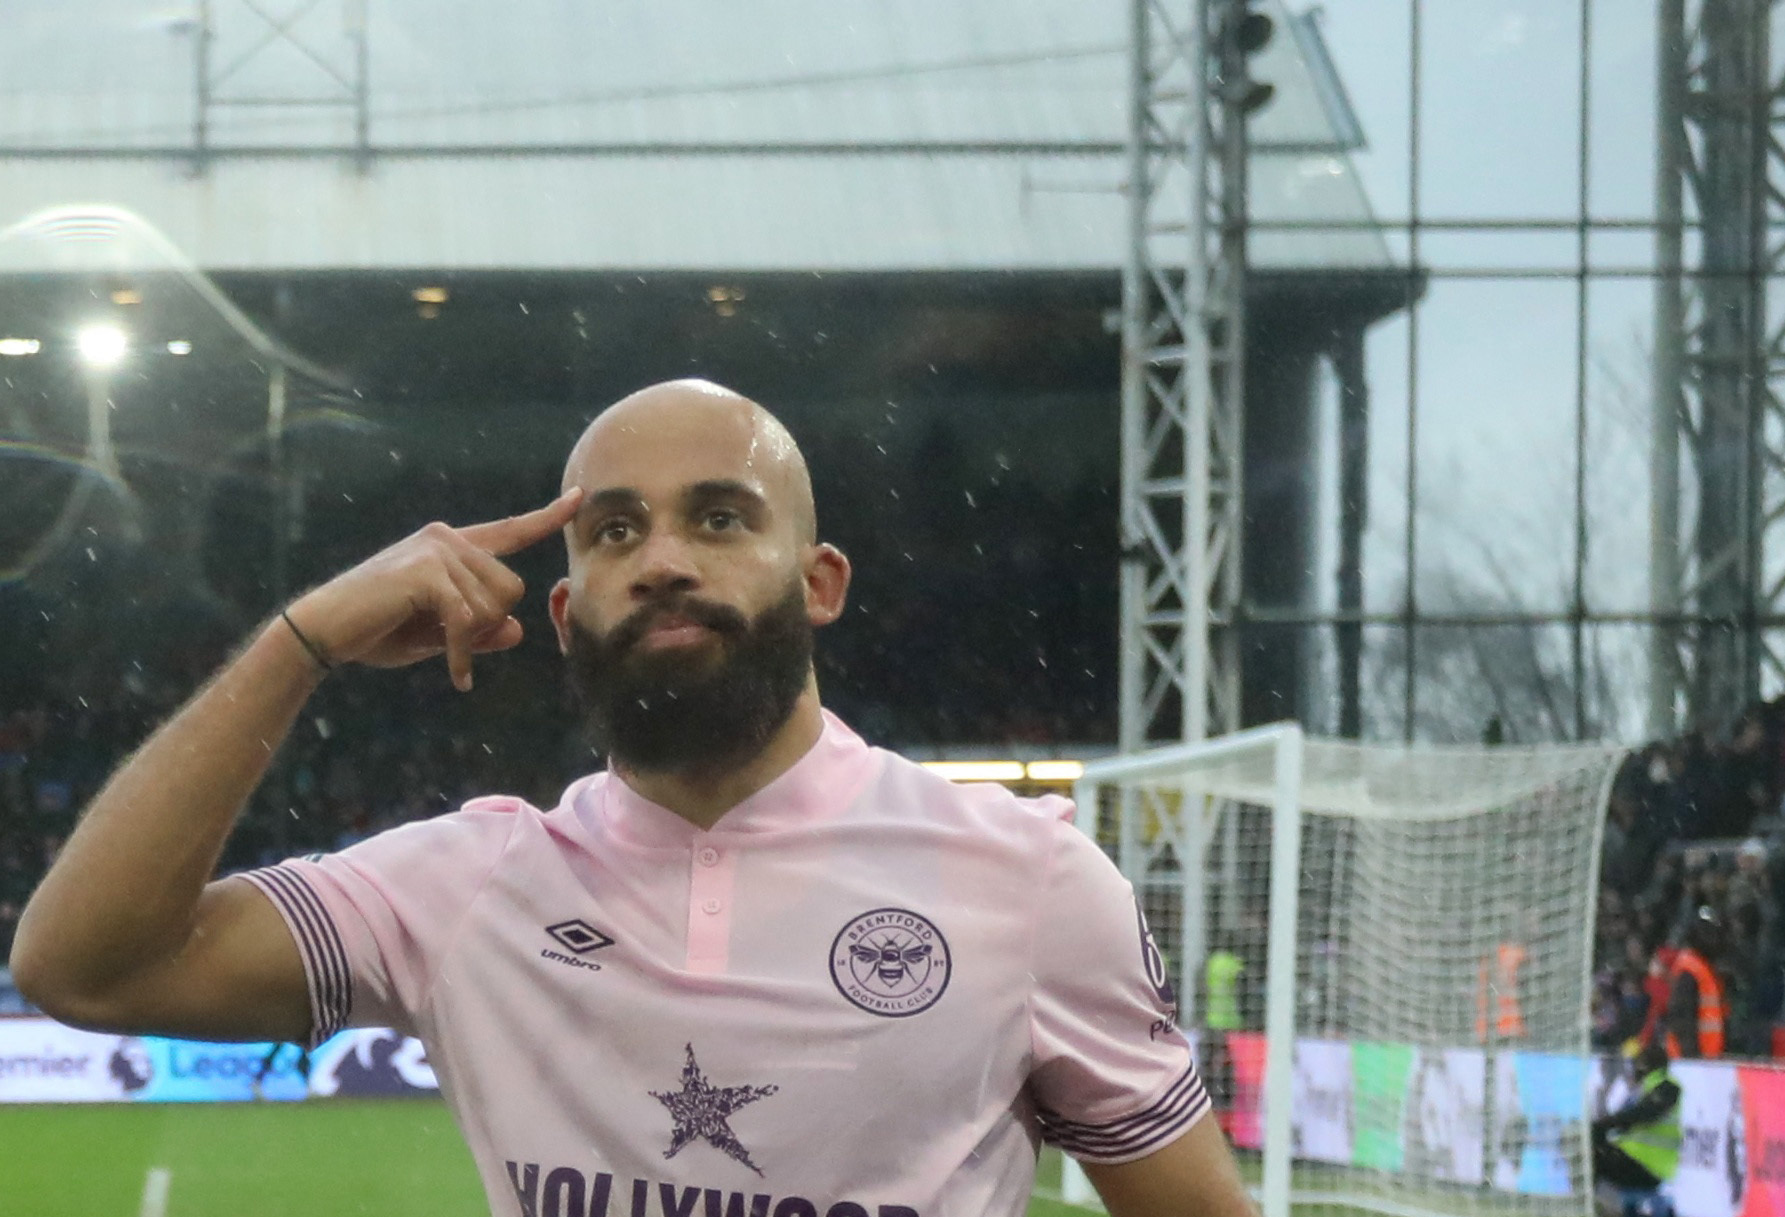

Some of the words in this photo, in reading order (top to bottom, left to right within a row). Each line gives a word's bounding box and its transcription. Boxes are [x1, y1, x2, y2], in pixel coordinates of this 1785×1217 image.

[848, 914, 933, 941] BRENTFORD
[541, 949, 602, 972] umbro
[848, 984, 904, 1010] FOOTBALL
